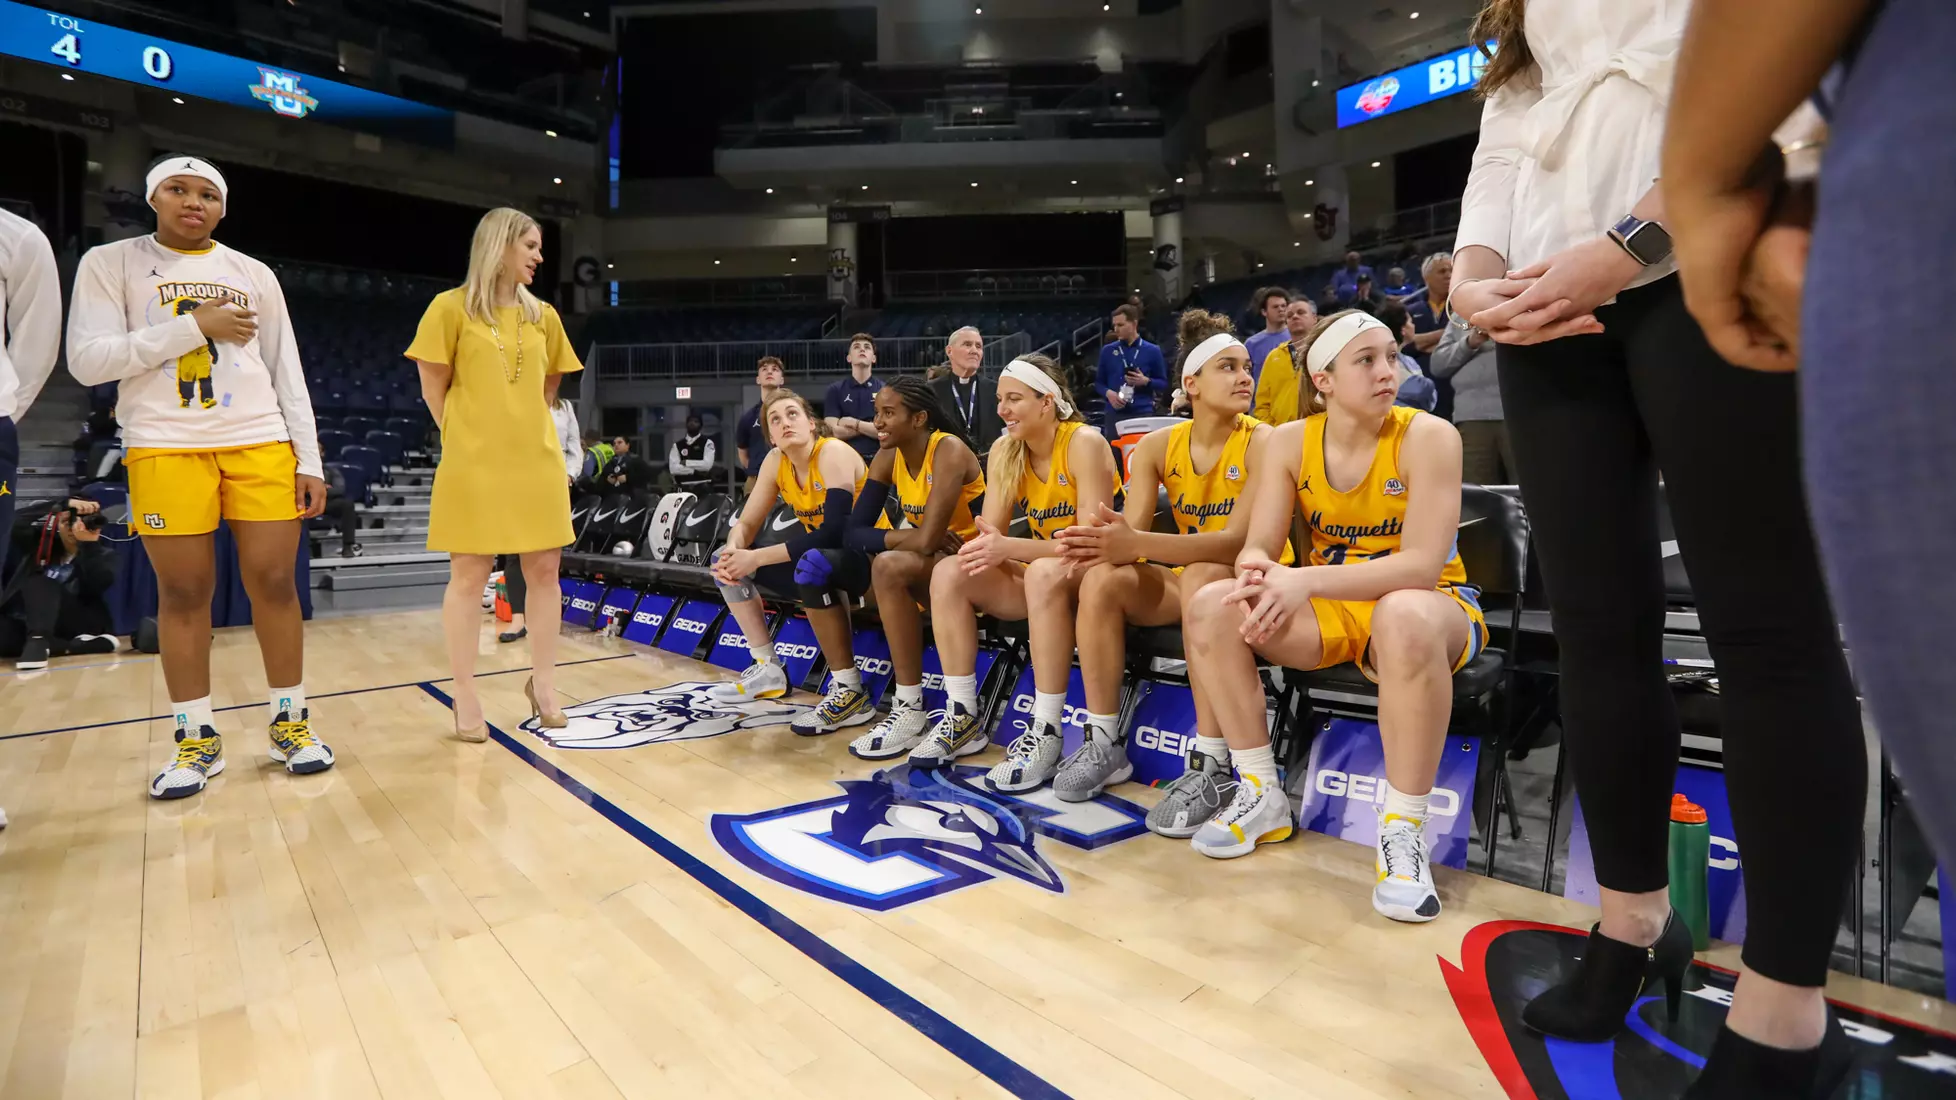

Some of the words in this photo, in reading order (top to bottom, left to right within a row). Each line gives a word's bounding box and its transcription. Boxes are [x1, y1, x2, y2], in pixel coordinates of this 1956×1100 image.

[47, 13, 84, 33] TOL
[51, 33, 81, 64] 4
[143, 46, 171, 80] 0
[0, 97, 27, 112] 02
[80, 111, 110, 128] 103
[1386, 480, 1399, 489] 40
[143, 513, 166, 529] MU
[571, 598, 596, 612] GEICO
[633, 611, 663, 627] GEICO
[672, 617, 707, 634] GEICO
[719, 633, 751, 649] GEIC
[773, 642, 818, 660] GEICO
[853, 654, 892, 675] EICO
[921, 672, 946, 691] GEI
[1315, 769, 1460, 816] GEIO
